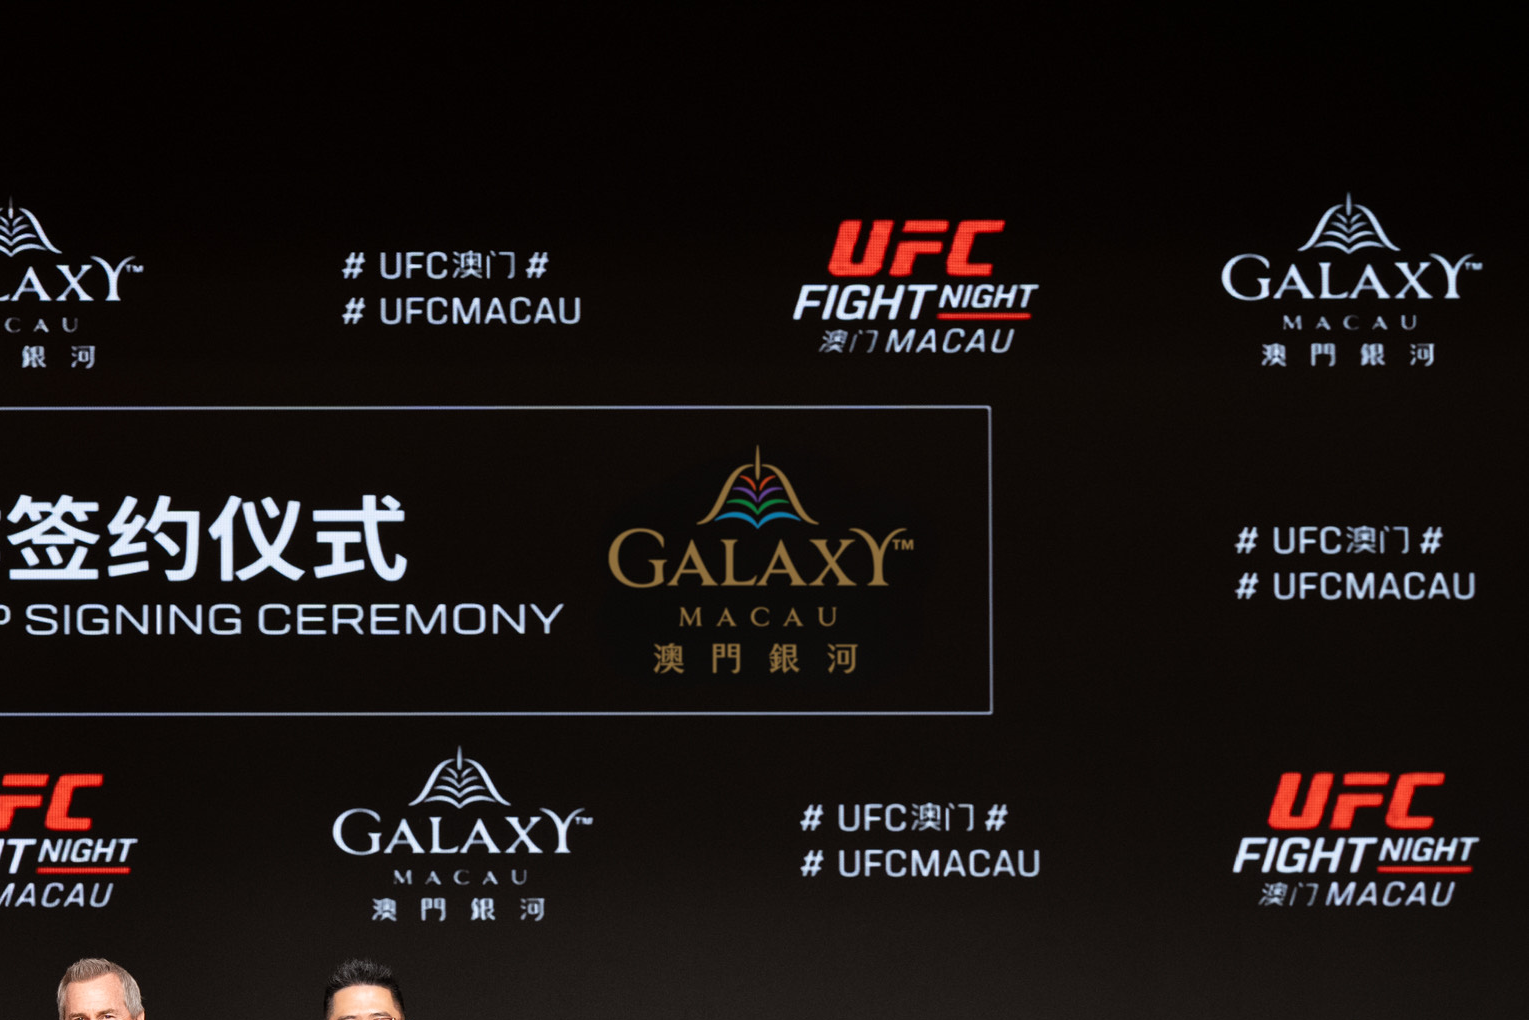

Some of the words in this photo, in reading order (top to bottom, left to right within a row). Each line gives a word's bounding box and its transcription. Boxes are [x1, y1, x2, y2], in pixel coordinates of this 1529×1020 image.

[827, 219, 1006, 277] UFC
[342, 252, 365, 279] #
[526, 252, 549, 278] #
[342, 297, 366, 324] #
[380, 297, 581, 325] UFCMACAU
[793, 284, 938, 320] FIGHT
[939, 284, 1039, 308] NIGHT
[1283, 315, 1416, 330] MACAU
[819, 329, 878, 353] 澳门
[885, 328, 1014, 353] MACAU
[1262, 343, 1434, 366] 澳門銀河
[1235, 527, 1258, 554] #
[1420, 527, 1443, 554] #
[1235, 572, 1259, 599] #
[1274, 572, 1475, 600] UFCMACAU
[25, 604, 242, 637] SIGNING
[257, 603, 565, 637] CEREMONY
[679, 606, 837, 627] MACAU
[653, 642, 858, 674] 澳門銀河
[1267, 772, 1446, 830] UFC
[800, 804, 824, 831] #
[985, 804, 1008, 831] #
[38, 838, 138, 862] NIGHT
[800, 850, 824, 876] #
[839, 849, 1040, 877] UFCMACAU
[1233, 837, 1378, 873] FIGHT
[1379, 837, 1480, 862] NIGHT
[394, 870, 526, 885] MACAU
[1259, 882, 1319, 906] 澳门
[1325, 881, 1455, 907] MACAU
[372, 898, 545, 921] 澳門銀河
